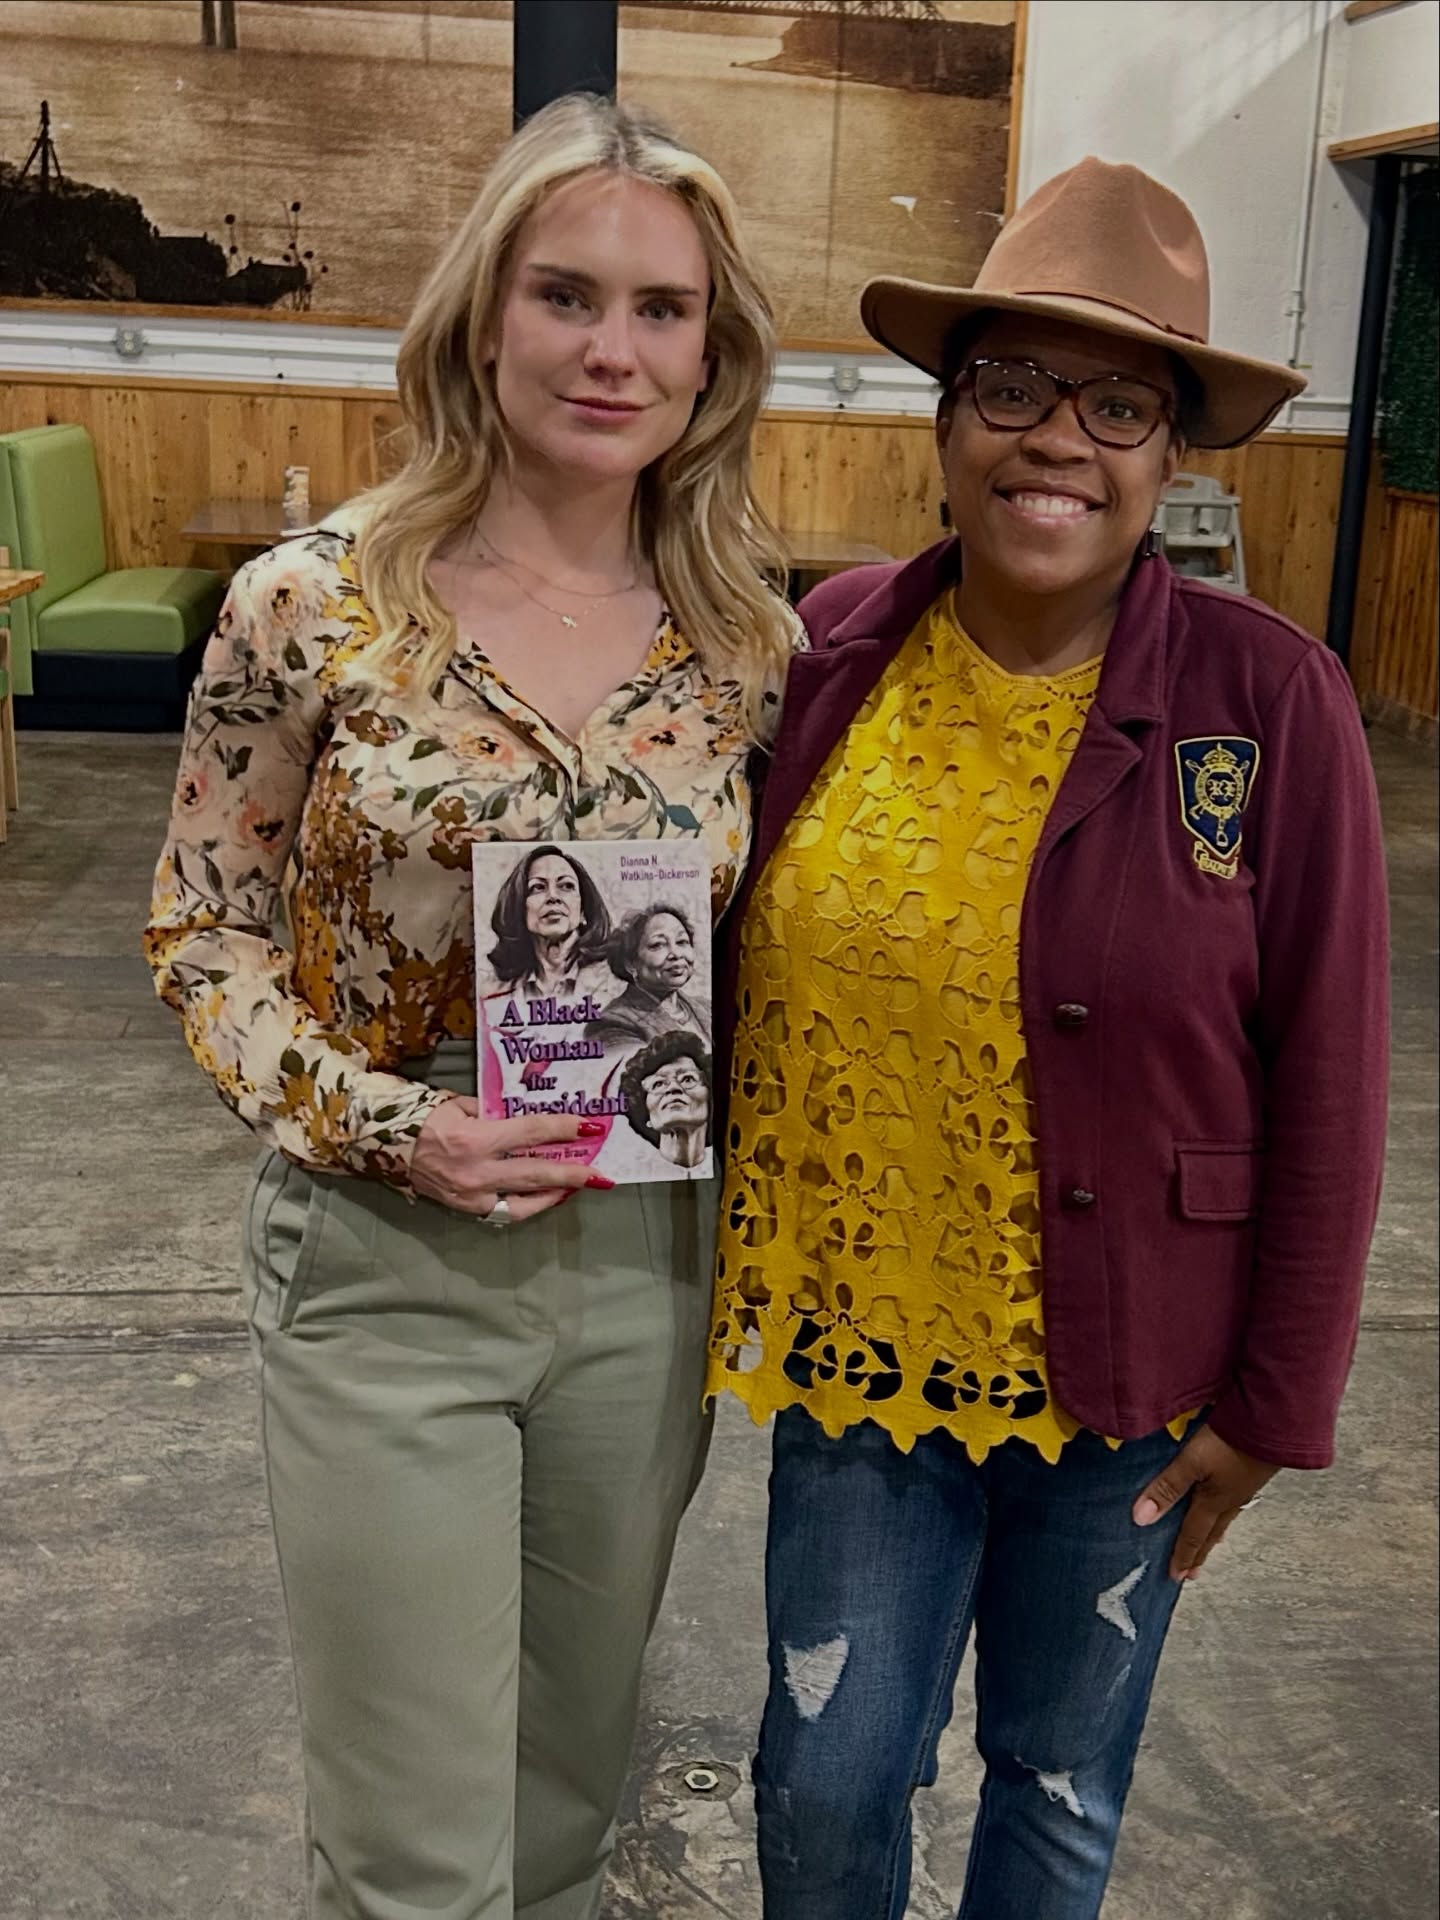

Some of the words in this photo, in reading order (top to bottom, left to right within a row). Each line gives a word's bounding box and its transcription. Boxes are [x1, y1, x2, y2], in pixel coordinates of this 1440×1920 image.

[620, 856, 649, 867] Dianna
[621, 869, 700, 880] Watkins-Dickerson
[500, 1000, 524, 1026] A
[527, 995, 602, 1026] Black
[500, 1037, 605, 1064] Woman
[526, 1072, 558, 1091] for
[502, 1091, 629, 1119] President
